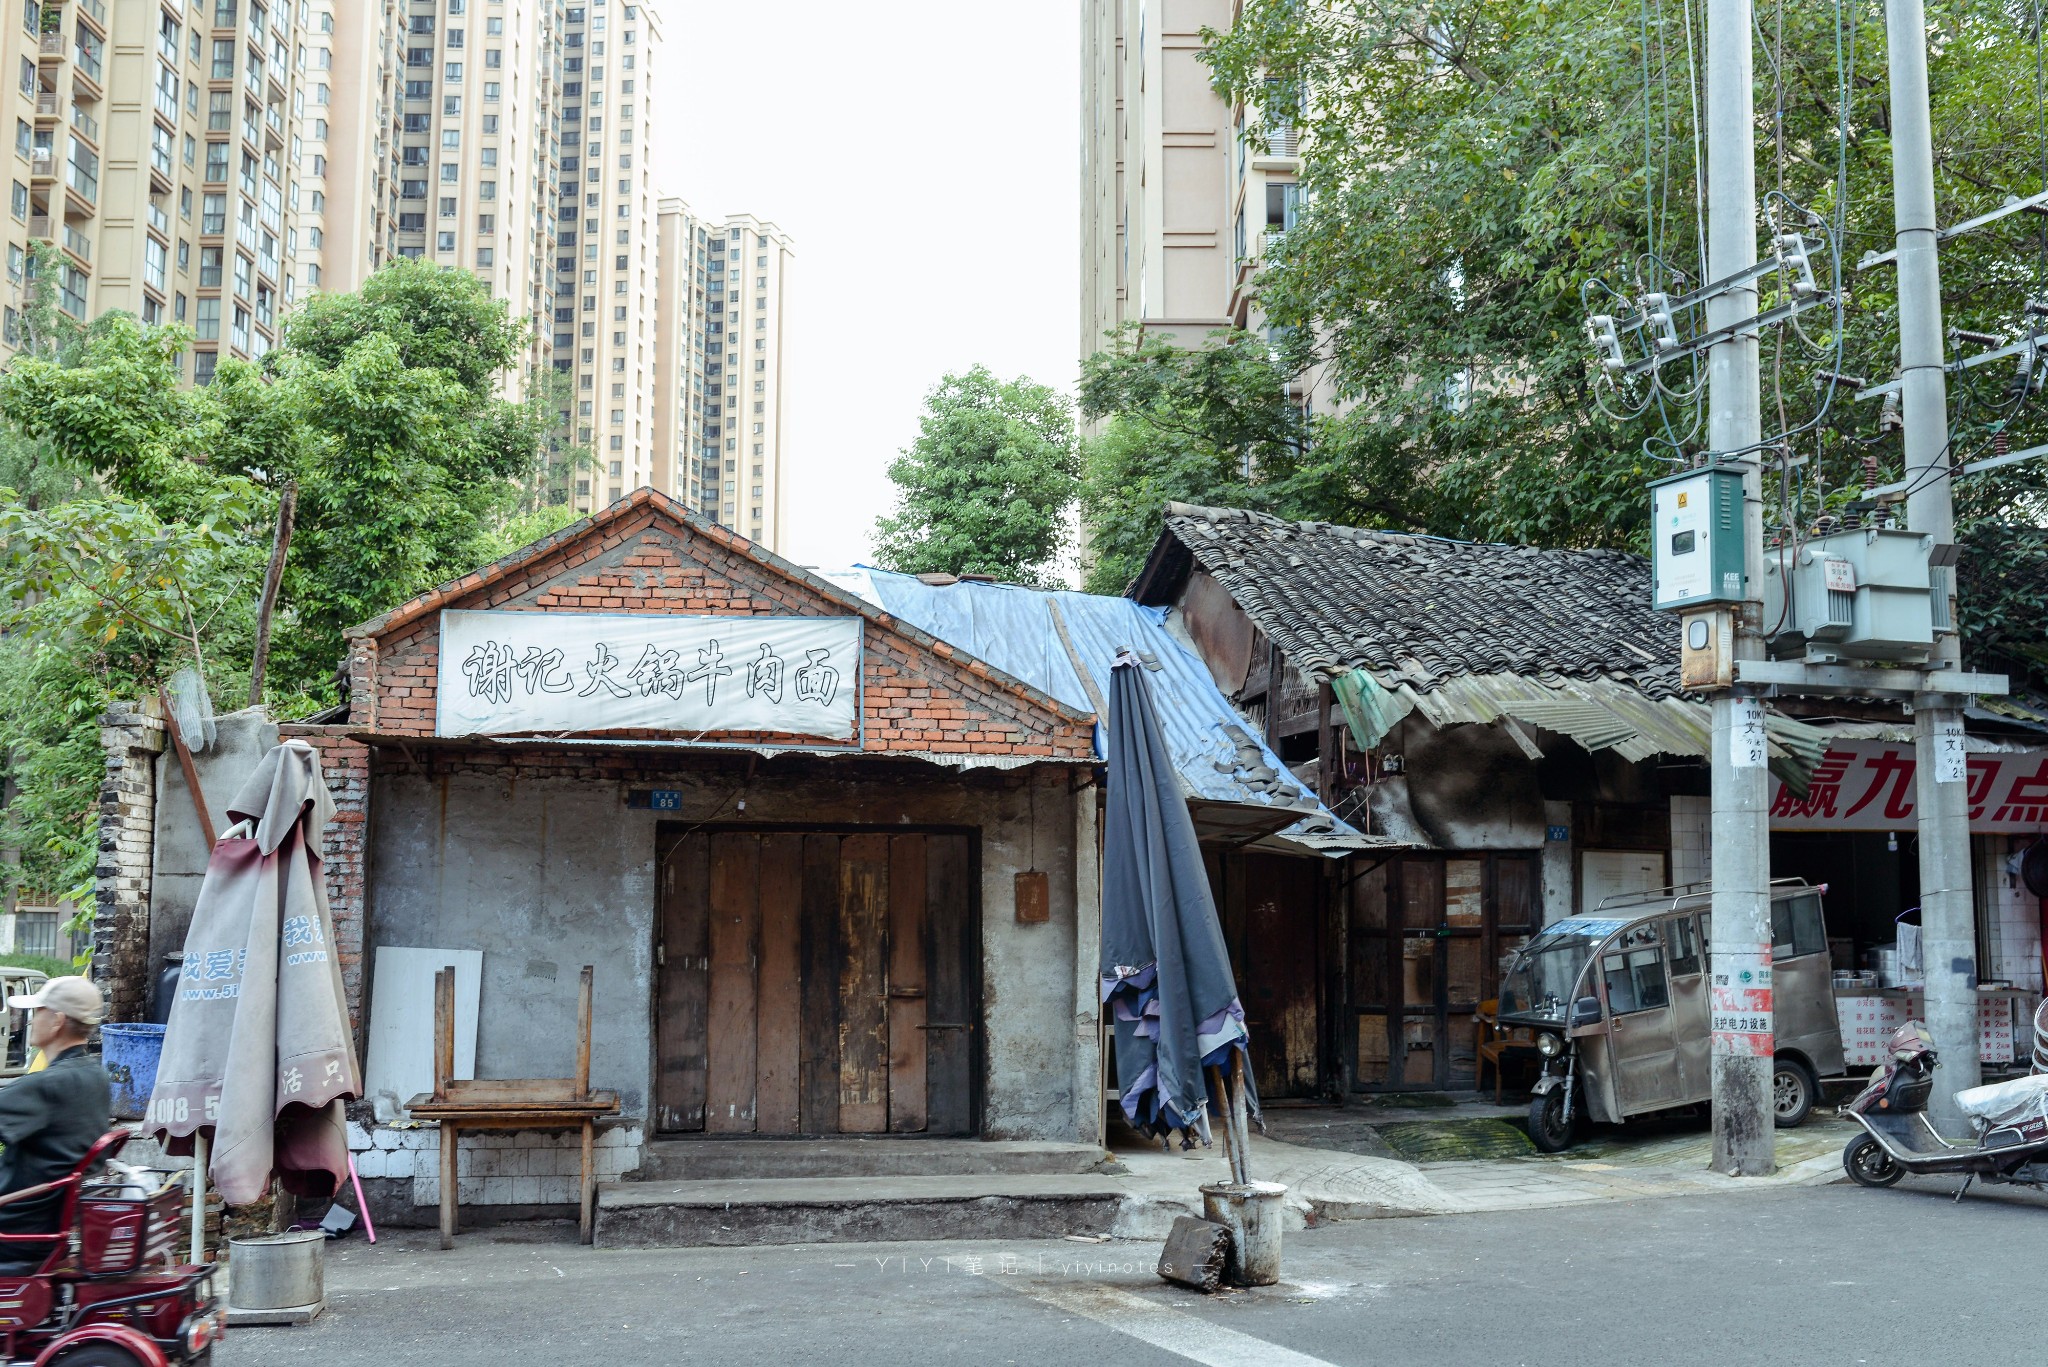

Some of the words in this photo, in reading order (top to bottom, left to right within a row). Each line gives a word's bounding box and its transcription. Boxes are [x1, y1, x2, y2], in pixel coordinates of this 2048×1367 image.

[1724, 572, 1740, 580] KEE
[462, 639, 840, 707] 谢记火锅牛肉面
[1750, 749, 1763, 761] 27
[1952, 767, 1965, 778] 26
[660, 799, 673, 807] 85
